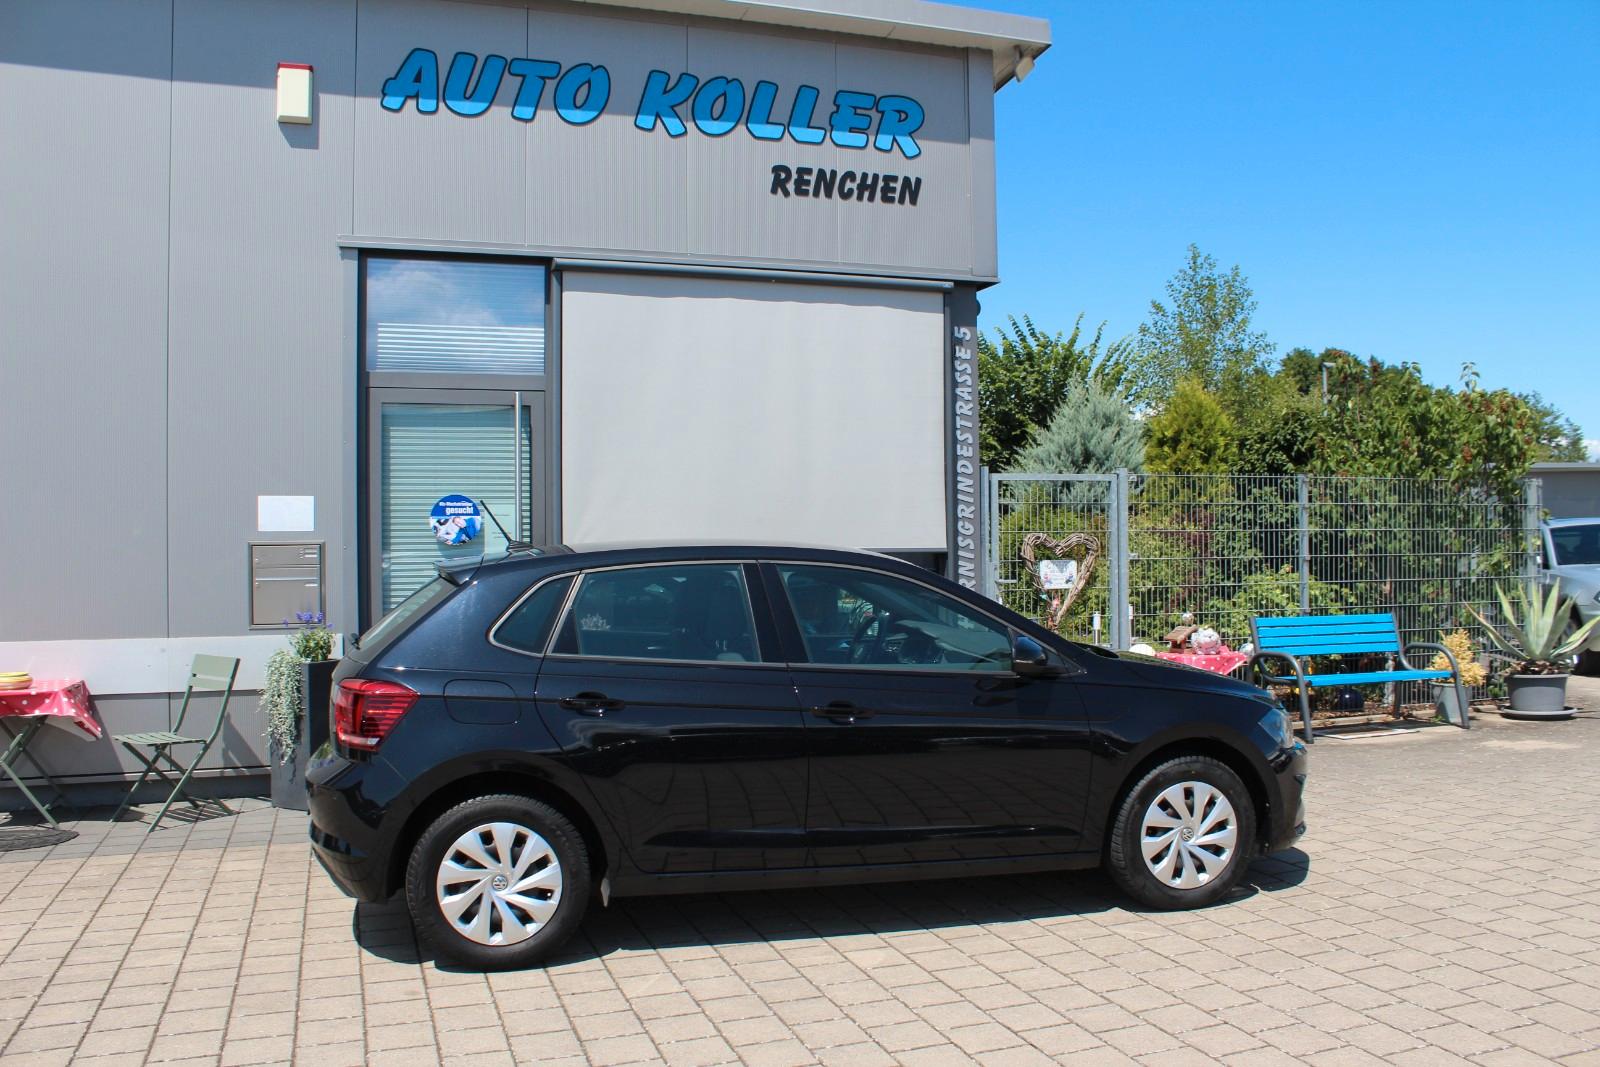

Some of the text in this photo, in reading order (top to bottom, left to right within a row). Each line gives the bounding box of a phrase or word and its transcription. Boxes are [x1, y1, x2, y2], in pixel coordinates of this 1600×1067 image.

[381, 47, 925, 159] AUTO KOLLER
[770, 164, 922, 206] RENCHEN
[954, 325, 972, 341] 5
